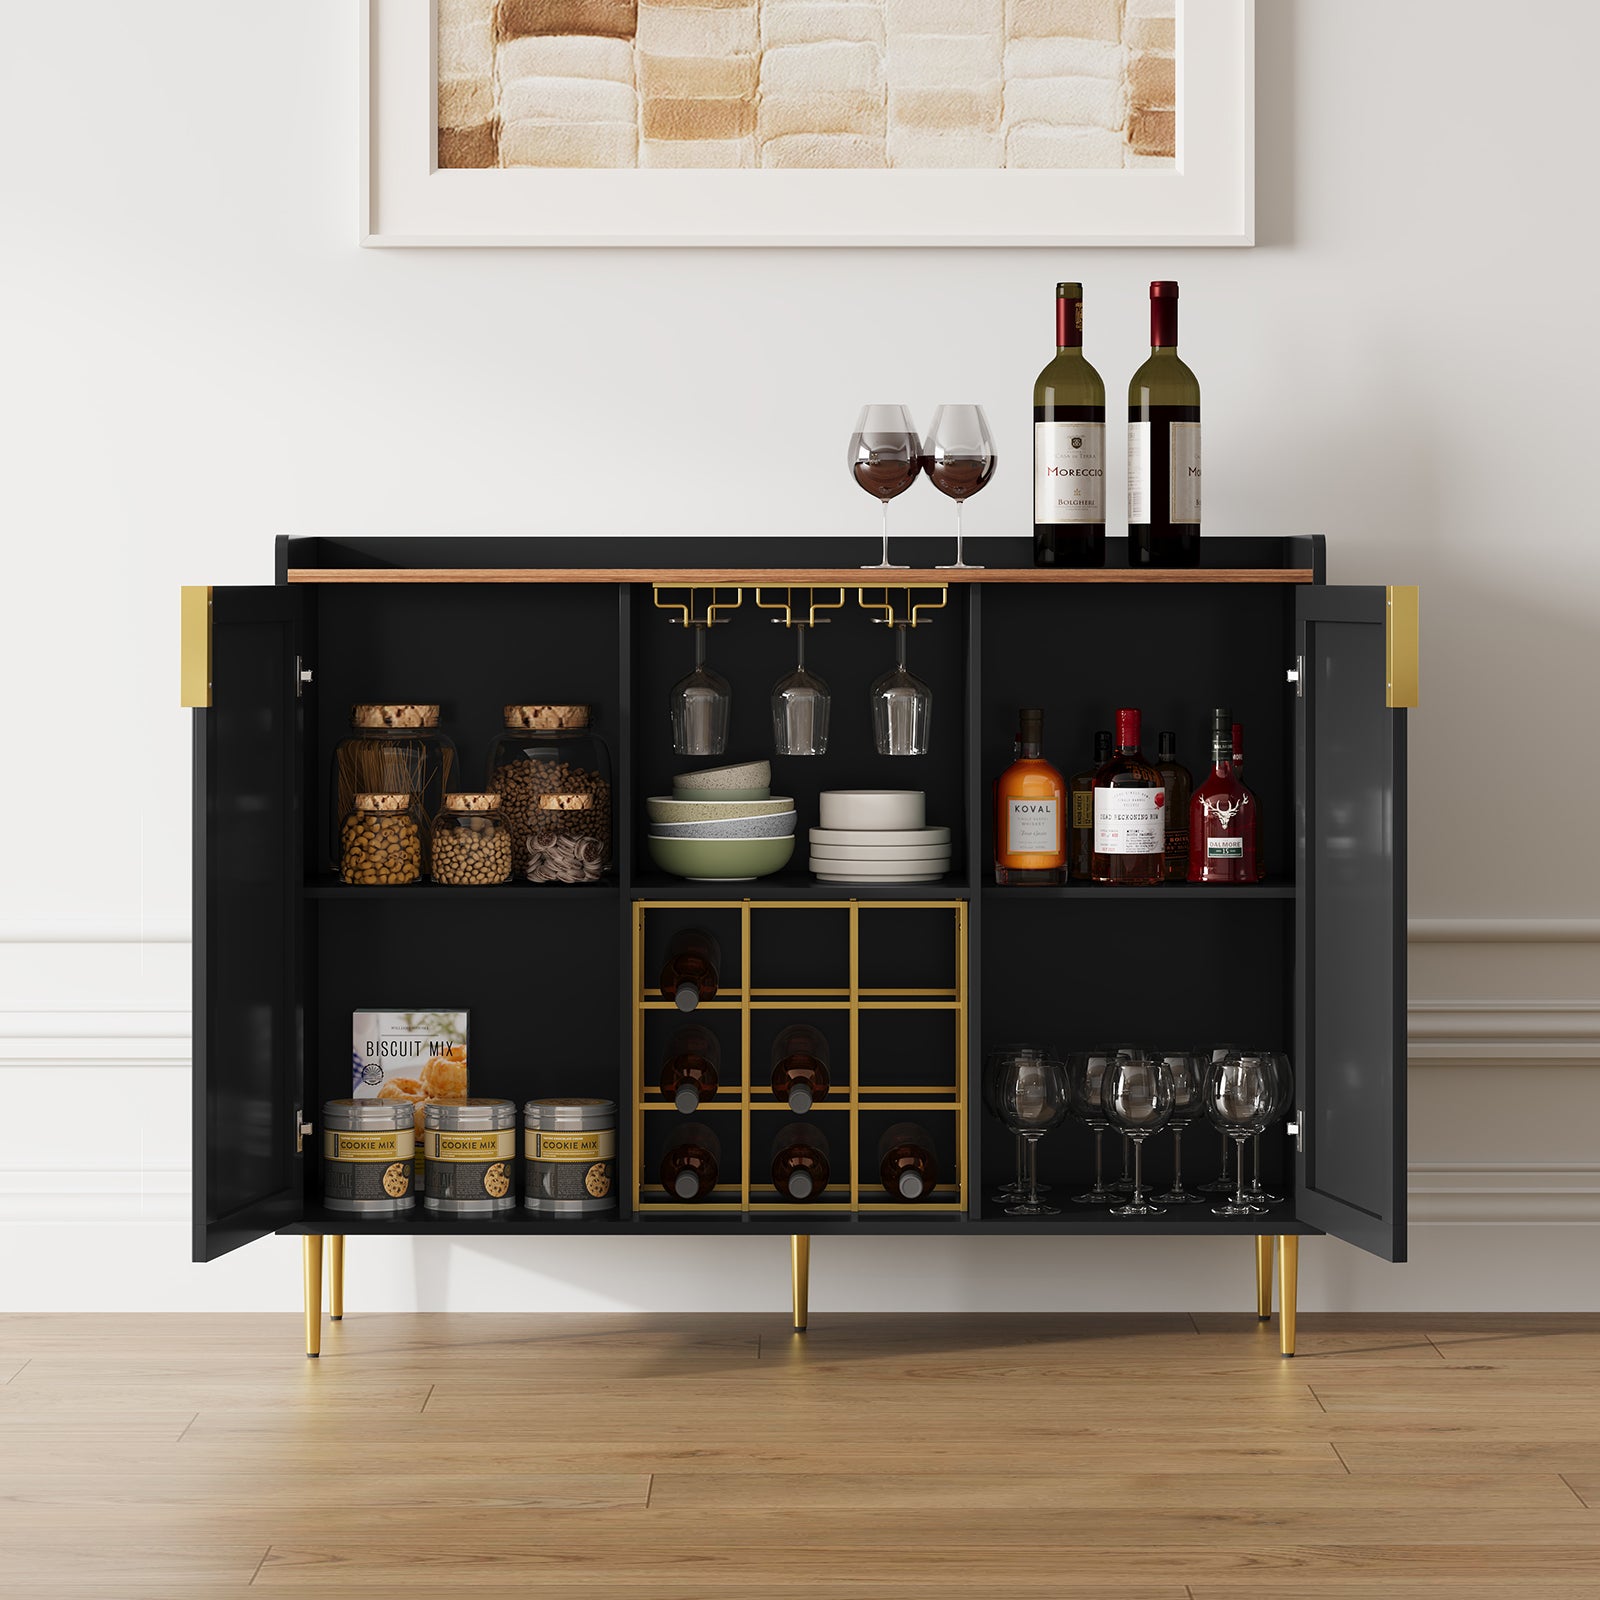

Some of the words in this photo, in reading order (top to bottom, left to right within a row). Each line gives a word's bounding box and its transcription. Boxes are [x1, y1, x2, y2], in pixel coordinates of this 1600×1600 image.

[1047, 467, 1103, 477] MORECCIO
[1014, 805, 1051, 813] KOVAL
[366, 1041, 422, 1057] BISCUIT
[429, 1041, 454, 1057] MIX
[340, 1141, 376, 1149] COOKIE
[378, 1141, 395, 1149] MIX
[441, 1141, 477, 1149] COOKIE
[479, 1141, 496, 1149] MIX
[542, 1141, 578, 1149] COOKIE
[581, 1141, 597, 1149] MIX
